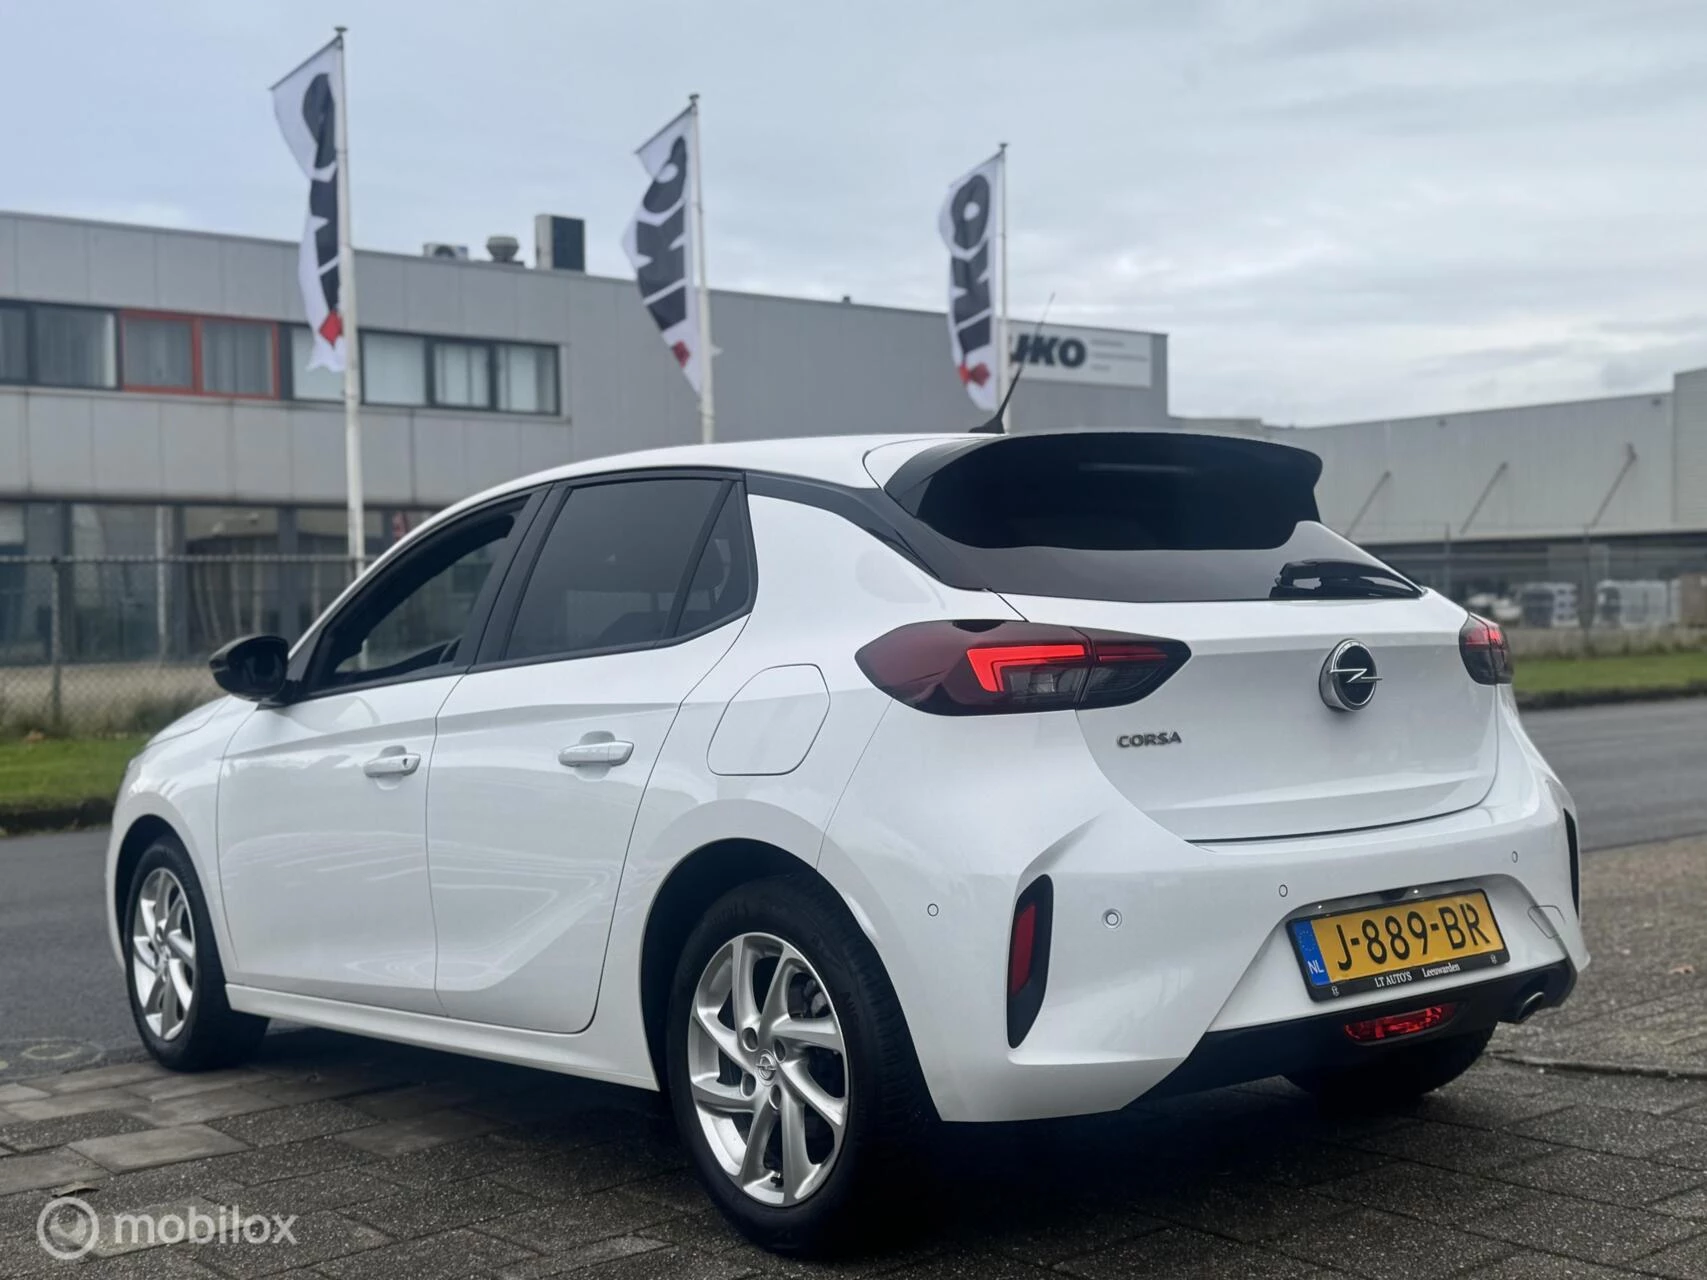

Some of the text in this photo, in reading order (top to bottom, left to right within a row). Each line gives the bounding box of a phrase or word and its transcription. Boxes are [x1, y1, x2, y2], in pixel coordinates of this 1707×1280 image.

[950, 173, 992, 356] IKO
[1117, 731, 1182, 748] CORSA
[1336, 903, 1491, 971] J-889-BR
[1307, 959, 1325, 975] NL
[1374, 976, 1385, 988] LT
[1421, 962, 1461, 978] Leeuwarden
